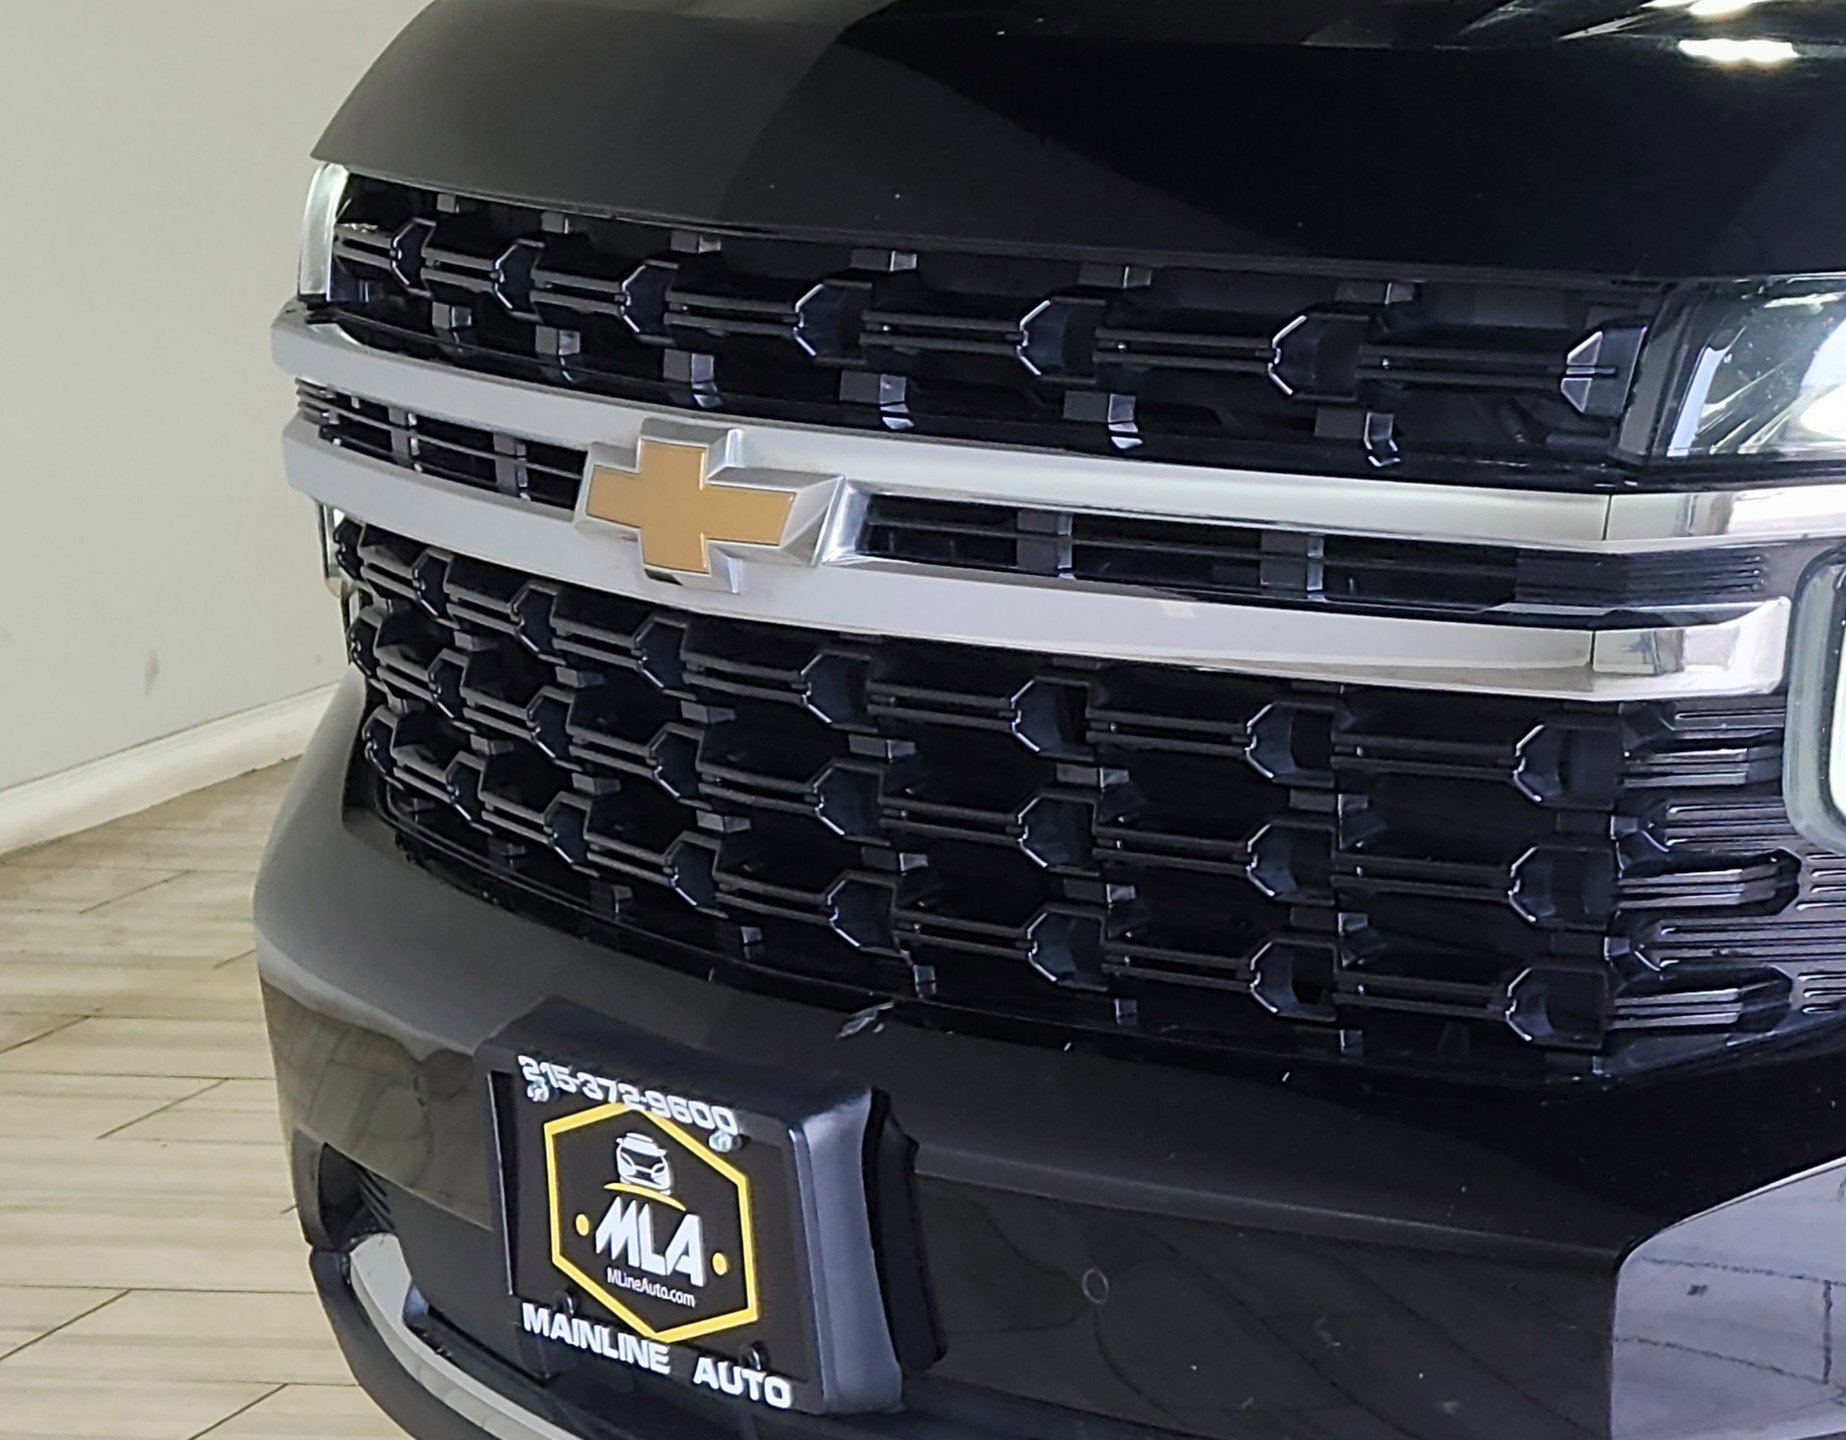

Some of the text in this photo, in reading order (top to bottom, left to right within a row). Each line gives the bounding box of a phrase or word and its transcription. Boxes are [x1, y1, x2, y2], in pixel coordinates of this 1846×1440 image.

[518, 1055, 739, 1137] 215-372-9600
[595, 1195, 706, 1288] MLA
[606, 1266, 696, 1308] MLineAuto.com
[522, 1303, 792, 1409] MAINLINE AUTO
